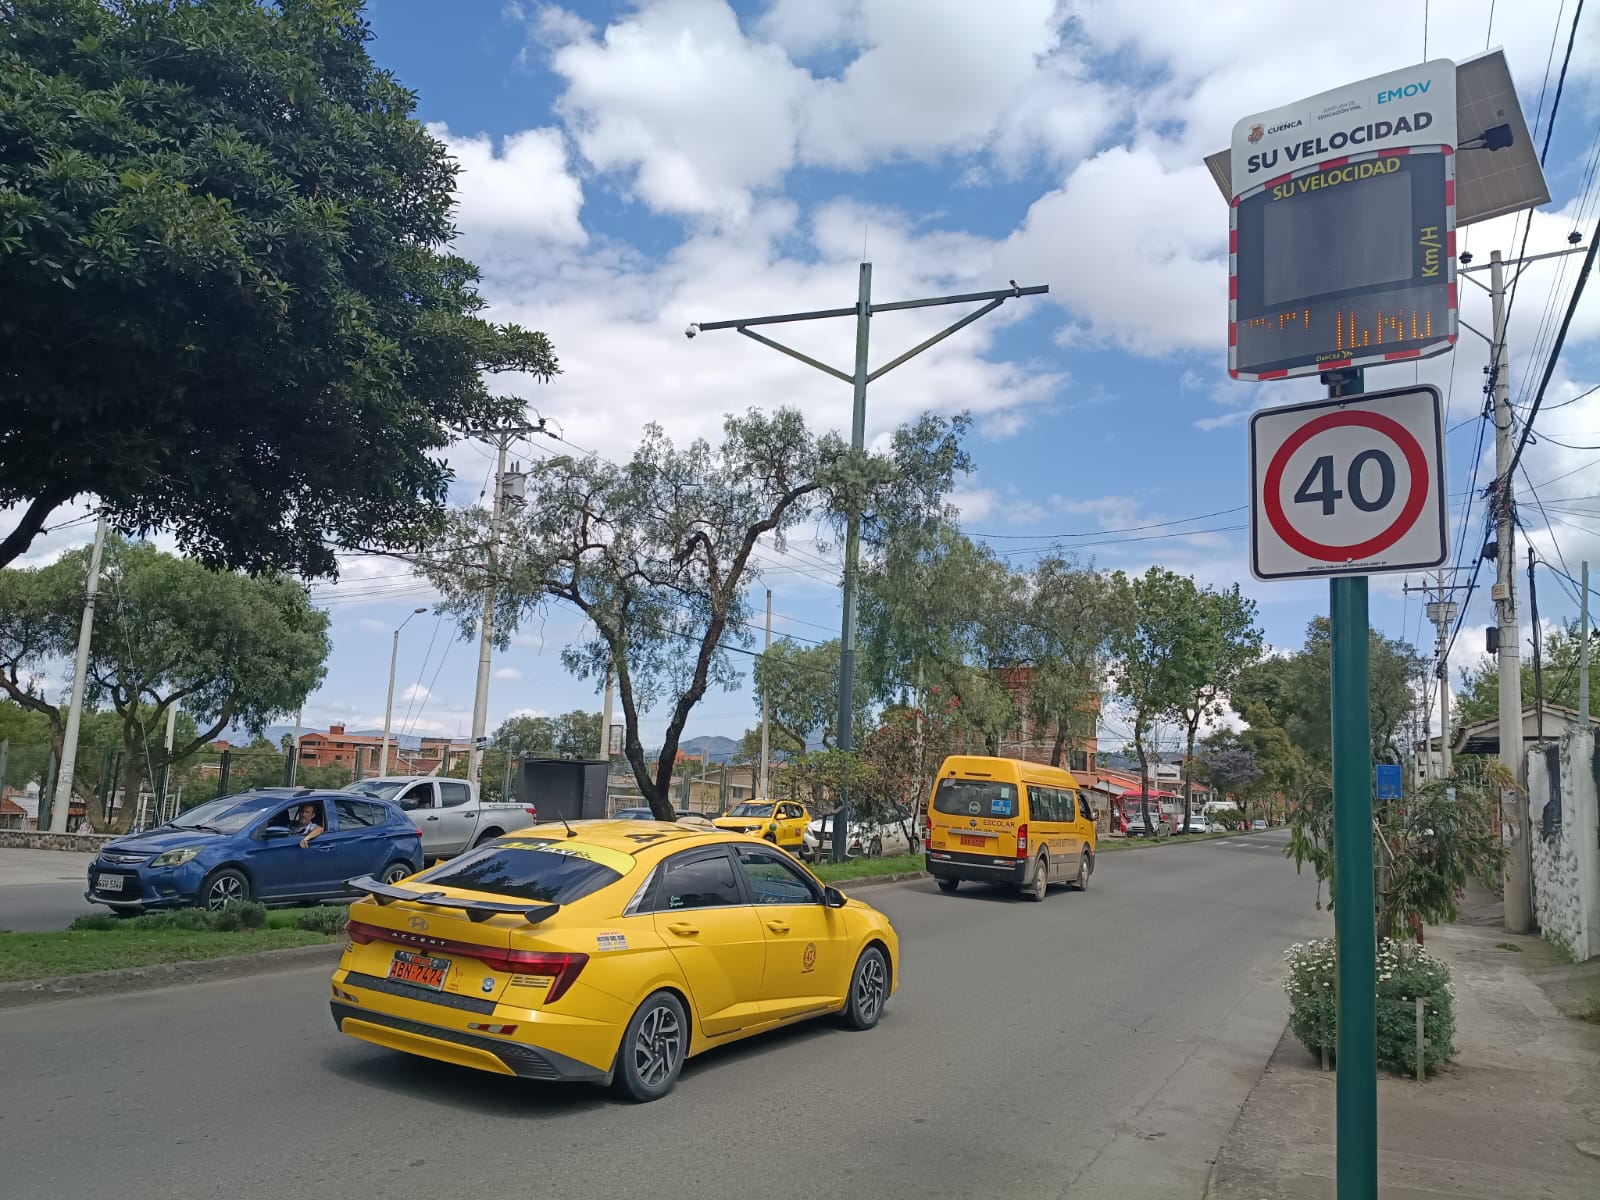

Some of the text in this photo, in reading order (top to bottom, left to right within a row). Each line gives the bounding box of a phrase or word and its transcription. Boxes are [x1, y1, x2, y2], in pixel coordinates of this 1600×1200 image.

[1377, 80, 1432, 105] EMOV
[1247, 112, 1432, 173] SU VELOCIDAD
[1267, 120, 1303, 135] CUENCA
[1273, 157, 1401, 201] SU VELOCIDAD
[1419, 226, 1442, 278] Km/H
[1293, 449, 1396, 516] 40
[983, 819, 1015, 827] ESCOLAR
[391, 932, 447, 946] ACCENT
